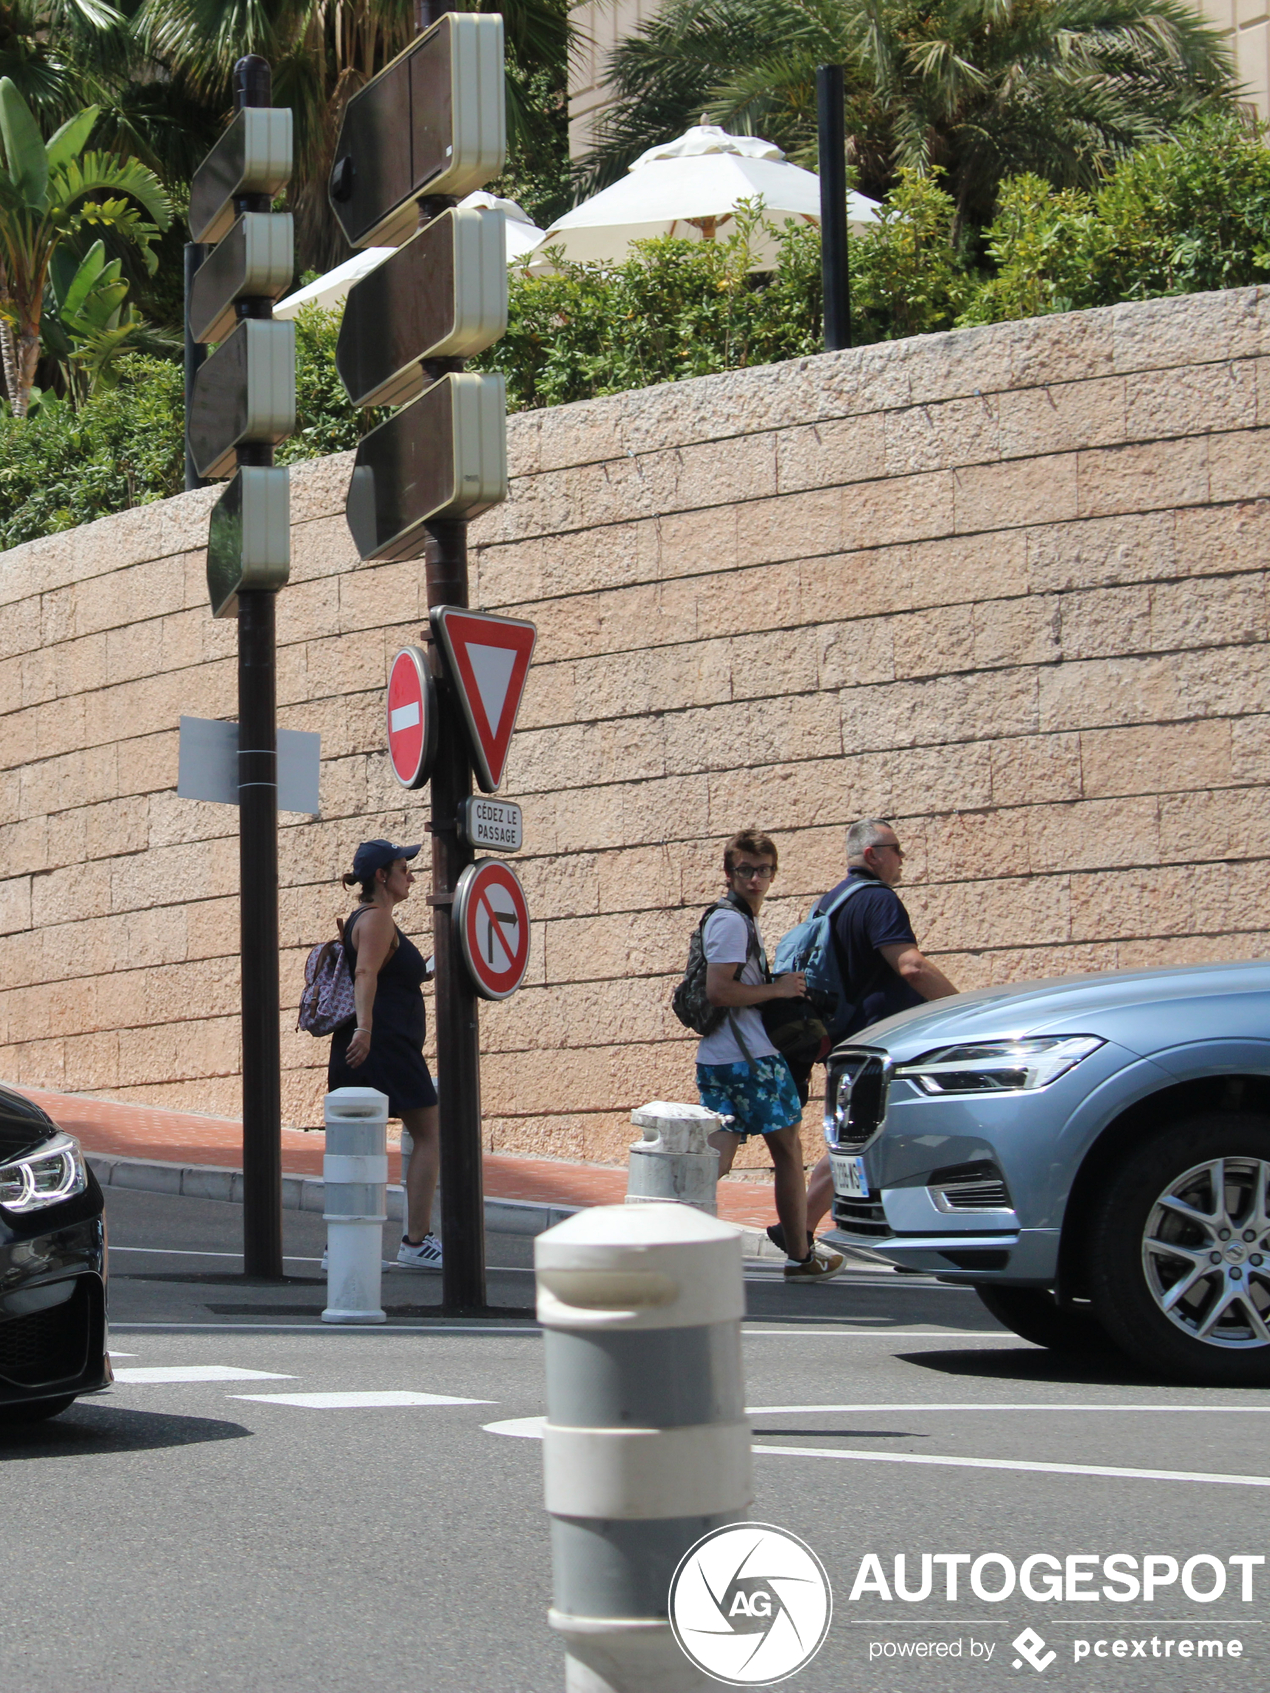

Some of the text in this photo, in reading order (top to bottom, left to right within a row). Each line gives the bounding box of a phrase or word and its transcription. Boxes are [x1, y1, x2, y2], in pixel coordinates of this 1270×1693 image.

[477, 802, 517, 825] CÉDEZ LE
[477, 824, 516, 844] PASSAGE
